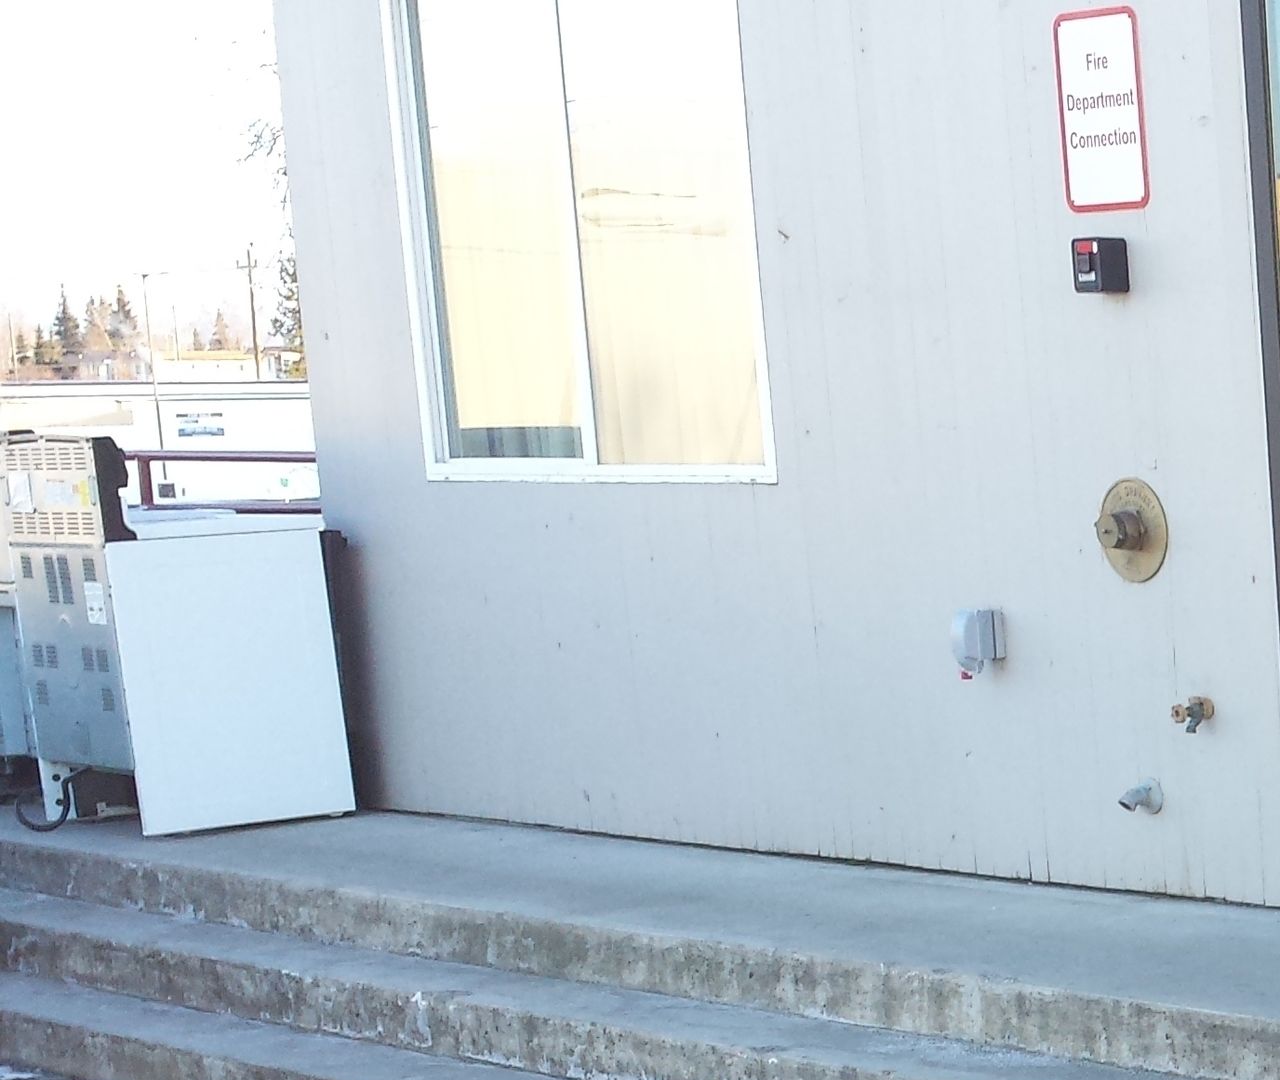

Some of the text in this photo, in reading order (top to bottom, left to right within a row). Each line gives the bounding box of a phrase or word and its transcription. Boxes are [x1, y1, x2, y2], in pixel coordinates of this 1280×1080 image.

[1085, 52, 1109, 72] Fire
[1066, 88, 1135, 115] Department
[1070, 127, 1137, 150] Connection
